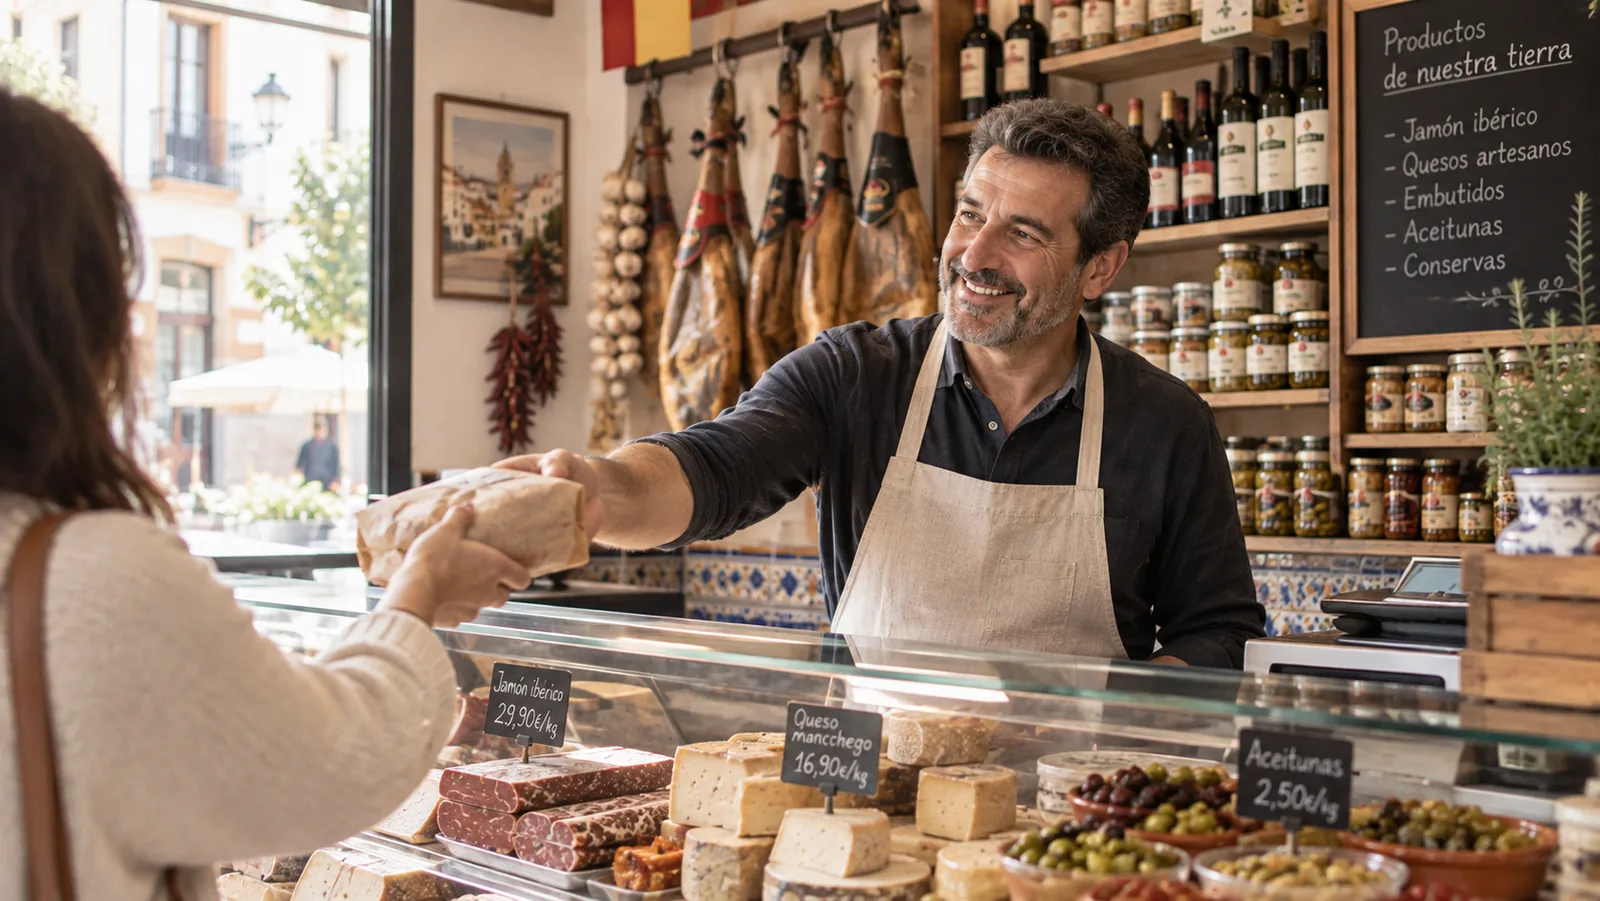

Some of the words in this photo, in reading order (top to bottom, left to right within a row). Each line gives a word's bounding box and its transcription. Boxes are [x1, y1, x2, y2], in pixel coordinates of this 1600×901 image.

[1383, 19, 1487, 57] Productos
[1383, 62, 1408, 91] de
[1417, 51, 1498, 85] nuestra
[1506, 42, 1573, 69] tierra
[1402, 115, 1465, 144] Jamón
[1473, 107, 1538, 133] ibérico
[1402, 151, 1469, 179] Quesos
[1476, 140, 1572, 167] artesanos
[1403, 177, 1505, 211] Embutidos
[1403, 217, 1504, 245] Aceitunas
[1403, 252, 1507, 278] Conservas
[493, 670, 528, 697] Jamón
[530, 676, 564, 702] ibérico
[493, 702, 559, 740] 29,90€/kg
[793, 707, 839, 730] Queso
[791, 729, 873, 757] mancchego
[1244, 738, 1345, 779] Aceitunas
[793, 751, 869, 790] 16,90€/kg
[1253, 777, 1341, 825] 2,50€/kg
